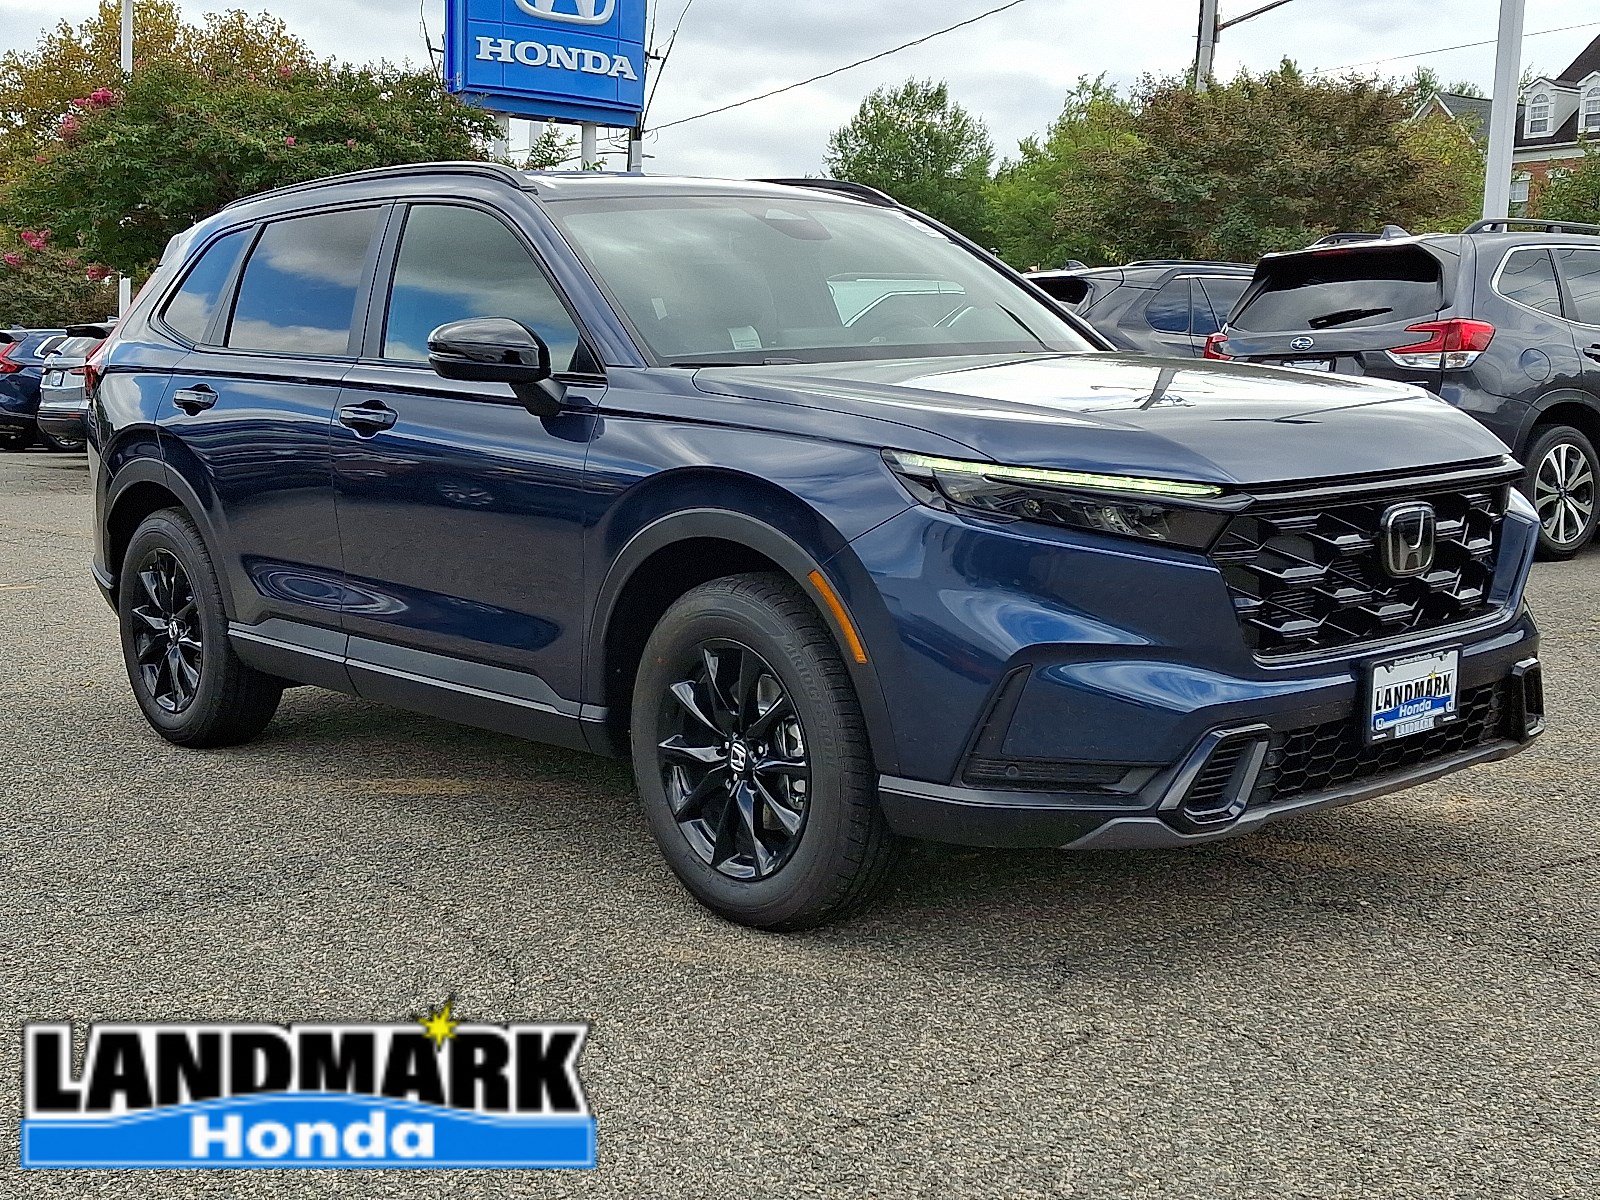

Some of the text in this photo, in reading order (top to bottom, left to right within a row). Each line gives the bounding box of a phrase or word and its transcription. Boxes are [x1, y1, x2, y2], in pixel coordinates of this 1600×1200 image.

[475, 36, 638, 81] HONDA
[1375, 673, 1452, 711] LANDMARK
[1399, 699, 1432, 717] Honda
[1395, 716, 1435, 738] LANDMARK
